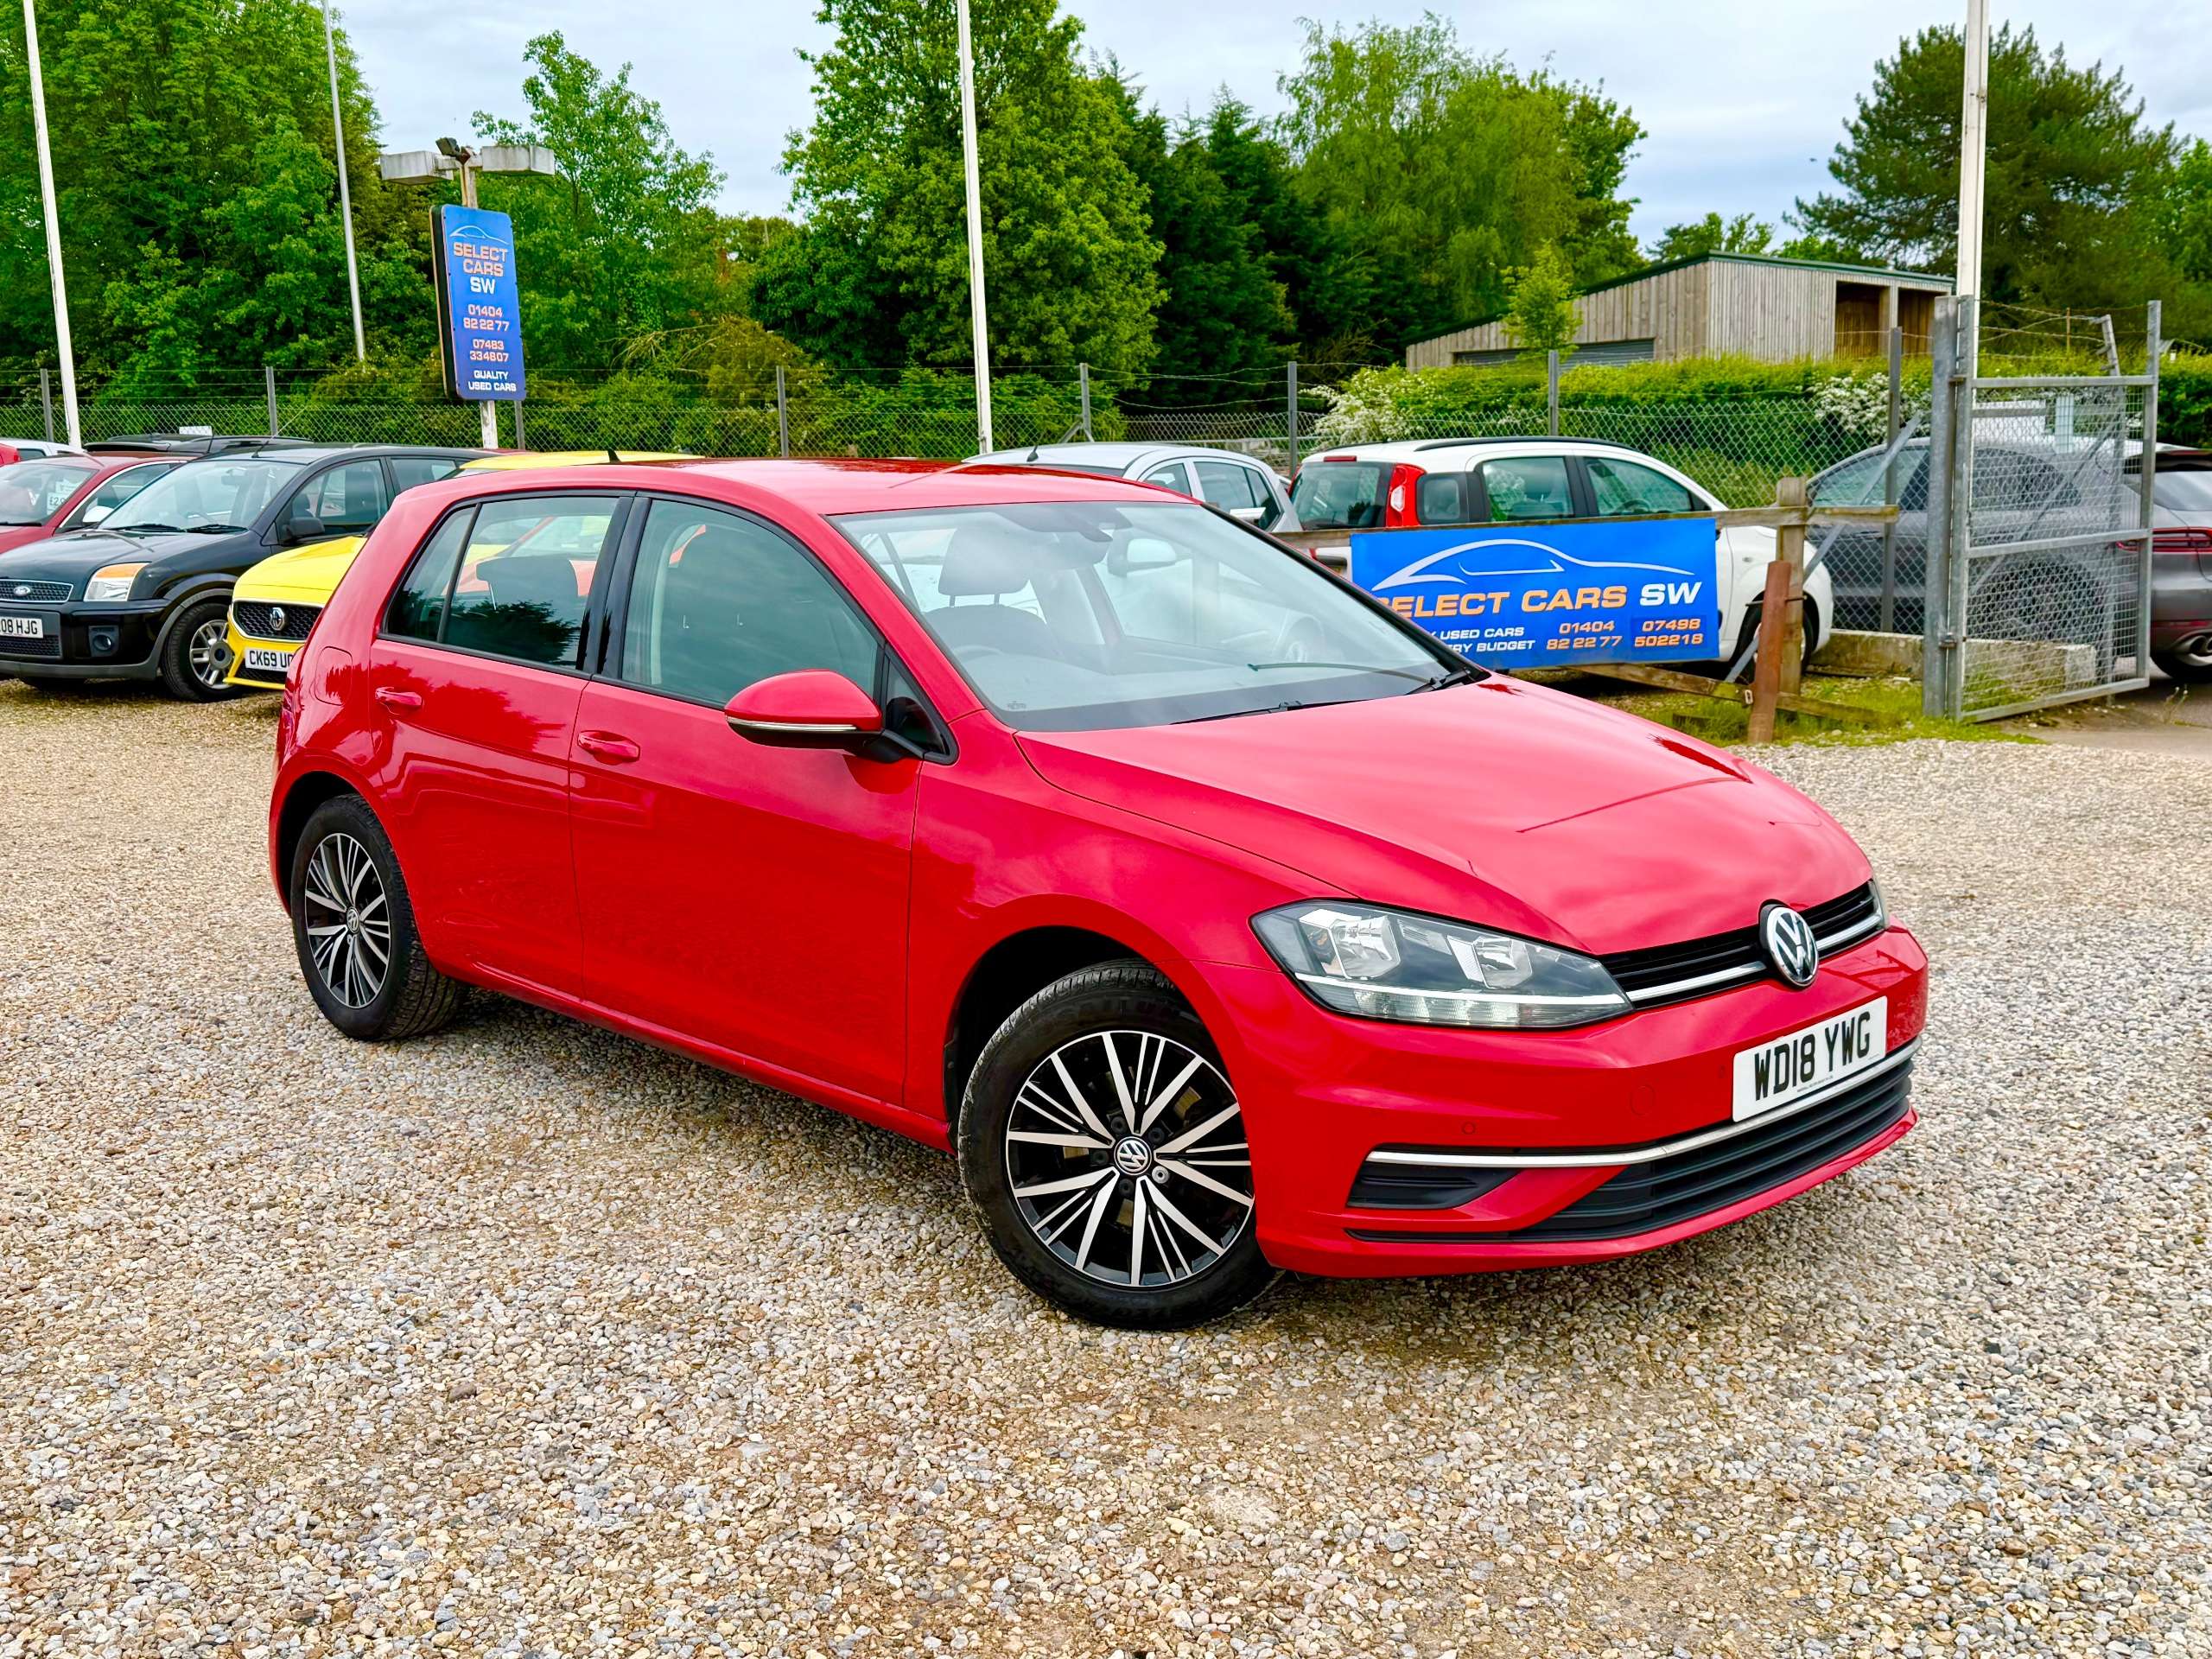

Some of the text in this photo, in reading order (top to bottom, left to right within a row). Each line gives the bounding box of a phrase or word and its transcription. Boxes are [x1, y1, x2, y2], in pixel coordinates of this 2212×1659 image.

[454, 242, 507, 263] SELECT
[463, 258, 504, 276] CARS
[470, 276, 495, 295] SW
[468, 303, 503, 317] 01404
[474, 370, 508, 379] QUALITY
[468, 381, 517, 391] USED CARS
[1521, 585, 1628, 613] CARS
[1639, 582, 1702, 607] SW
[16, 619, 38, 635] HJG
[1559, 620, 1615, 634] 01404
[1642, 618, 1701, 632] 07498
[1440, 629, 1480, 640] USED
[1484, 627, 1524, 638] CARS
[1634, 633, 1704, 648] 502218
[1476, 640, 1535, 652] BUDGET
[249, 650, 277, 667] CK69
[1754, 1011, 1871, 1102] WD18 YWG
